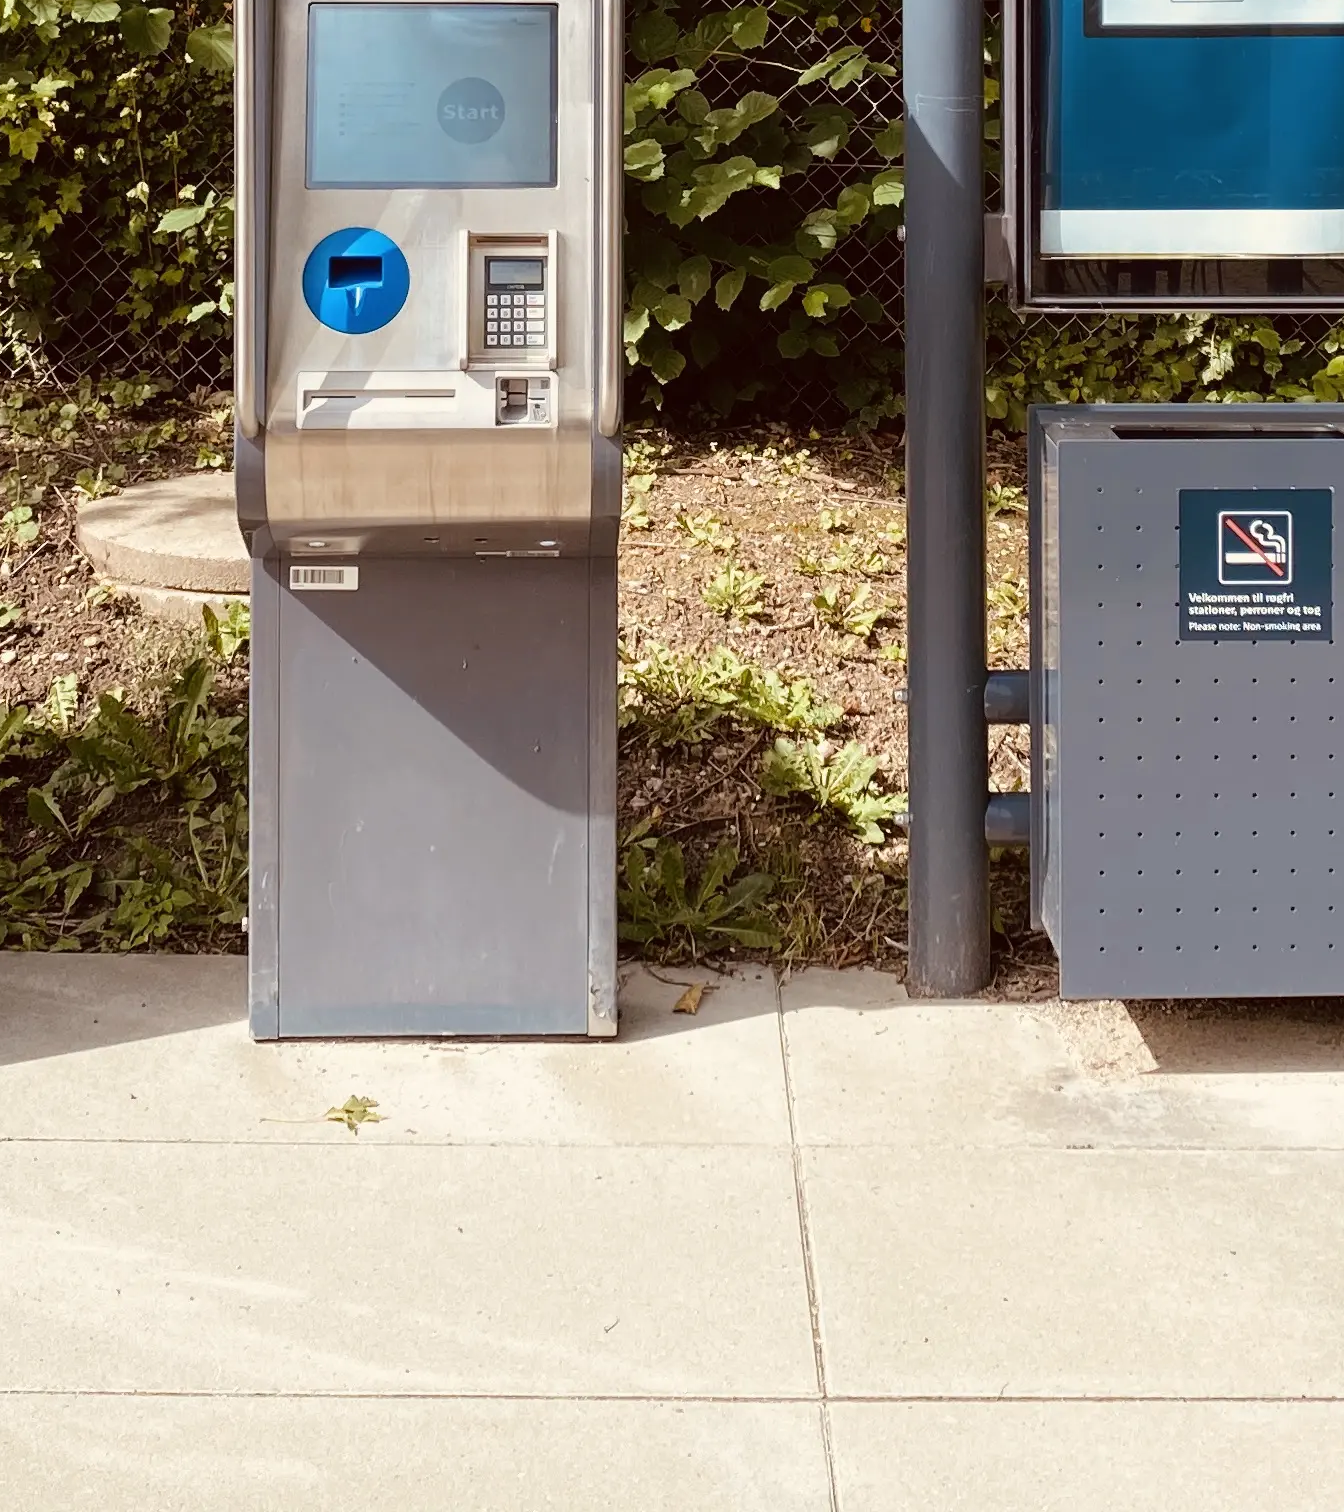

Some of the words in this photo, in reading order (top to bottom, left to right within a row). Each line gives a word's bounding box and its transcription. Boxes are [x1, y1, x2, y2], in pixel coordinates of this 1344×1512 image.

[442, 104, 499, 120] Start
[1189, 593, 1250, 602] Velkommen
[1252, 593, 1263, 602] til
[1266, 593, 1294, 604] røgfri
[1189, 605, 1237, 616] stationer,
[1240, 607, 1285, 616] perroner
[1287, 606, 1301, 616] og
[1303, 606, 1321, 616] tog
[1189, 622, 1217, 630] Please
[1243, 622, 1300, 631] Non-smoking
